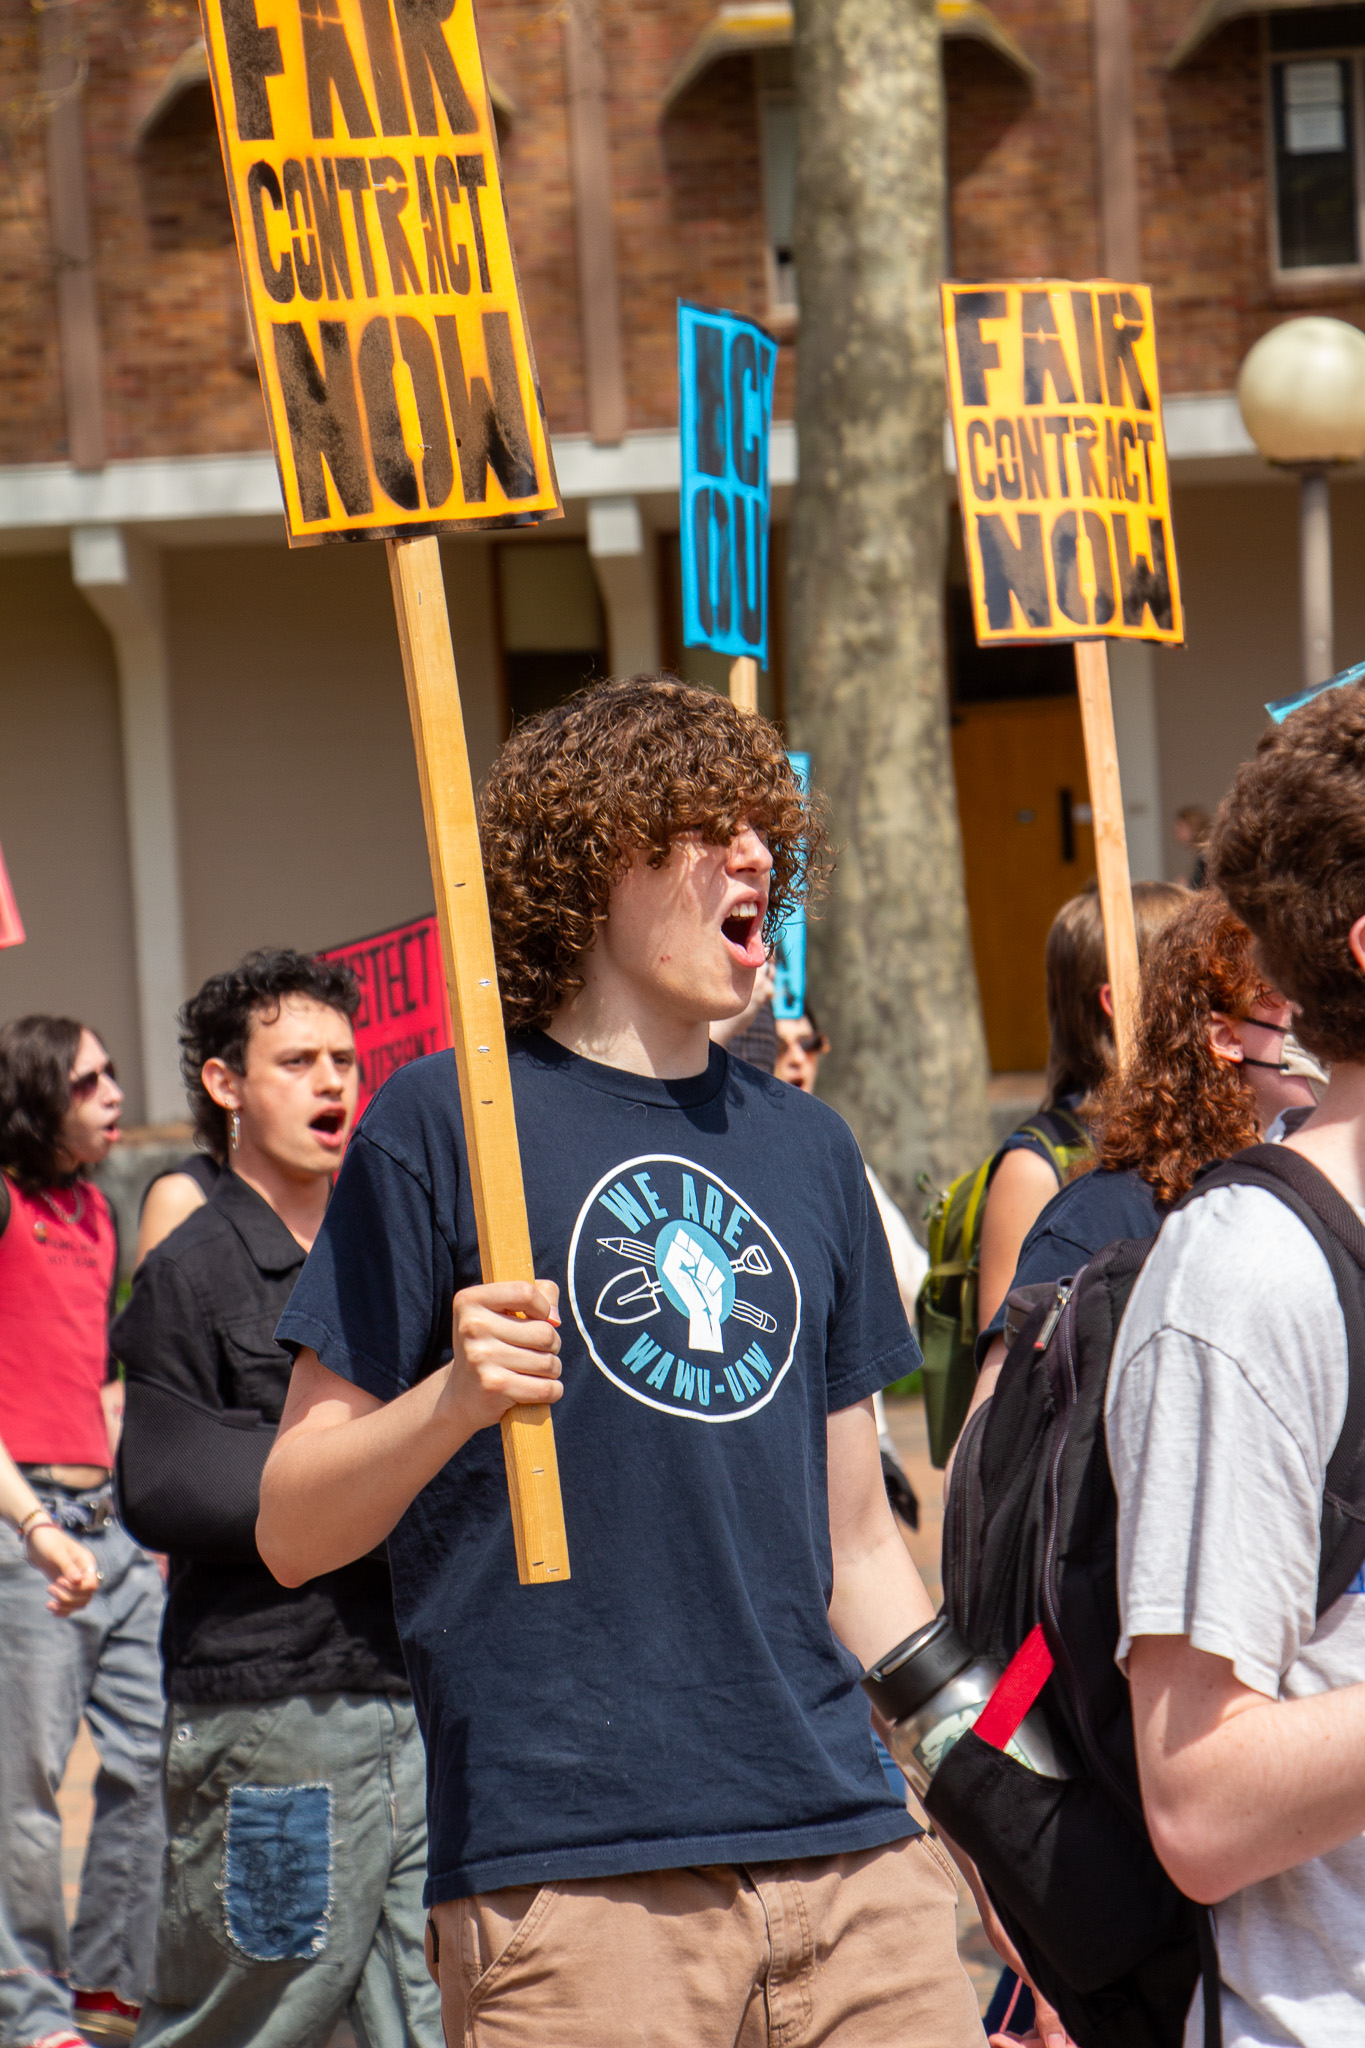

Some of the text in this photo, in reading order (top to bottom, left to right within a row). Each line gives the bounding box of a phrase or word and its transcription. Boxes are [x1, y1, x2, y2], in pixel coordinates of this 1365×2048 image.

[220, 0, 480, 141] FAIR
[247, 154, 492, 303] CONTRACT
[953, 290, 1153, 412] FAIR
[272, 312, 540, 523] NOW
[967, 414, 1156, 506] CONTRACT
[693, 486, 766, 645] OU
[976, 508, 1175, 631] NOW
[599, 1171, 751, 1250] WE ARE
[621, 1331, 773, 1407] WAWU-UAW
